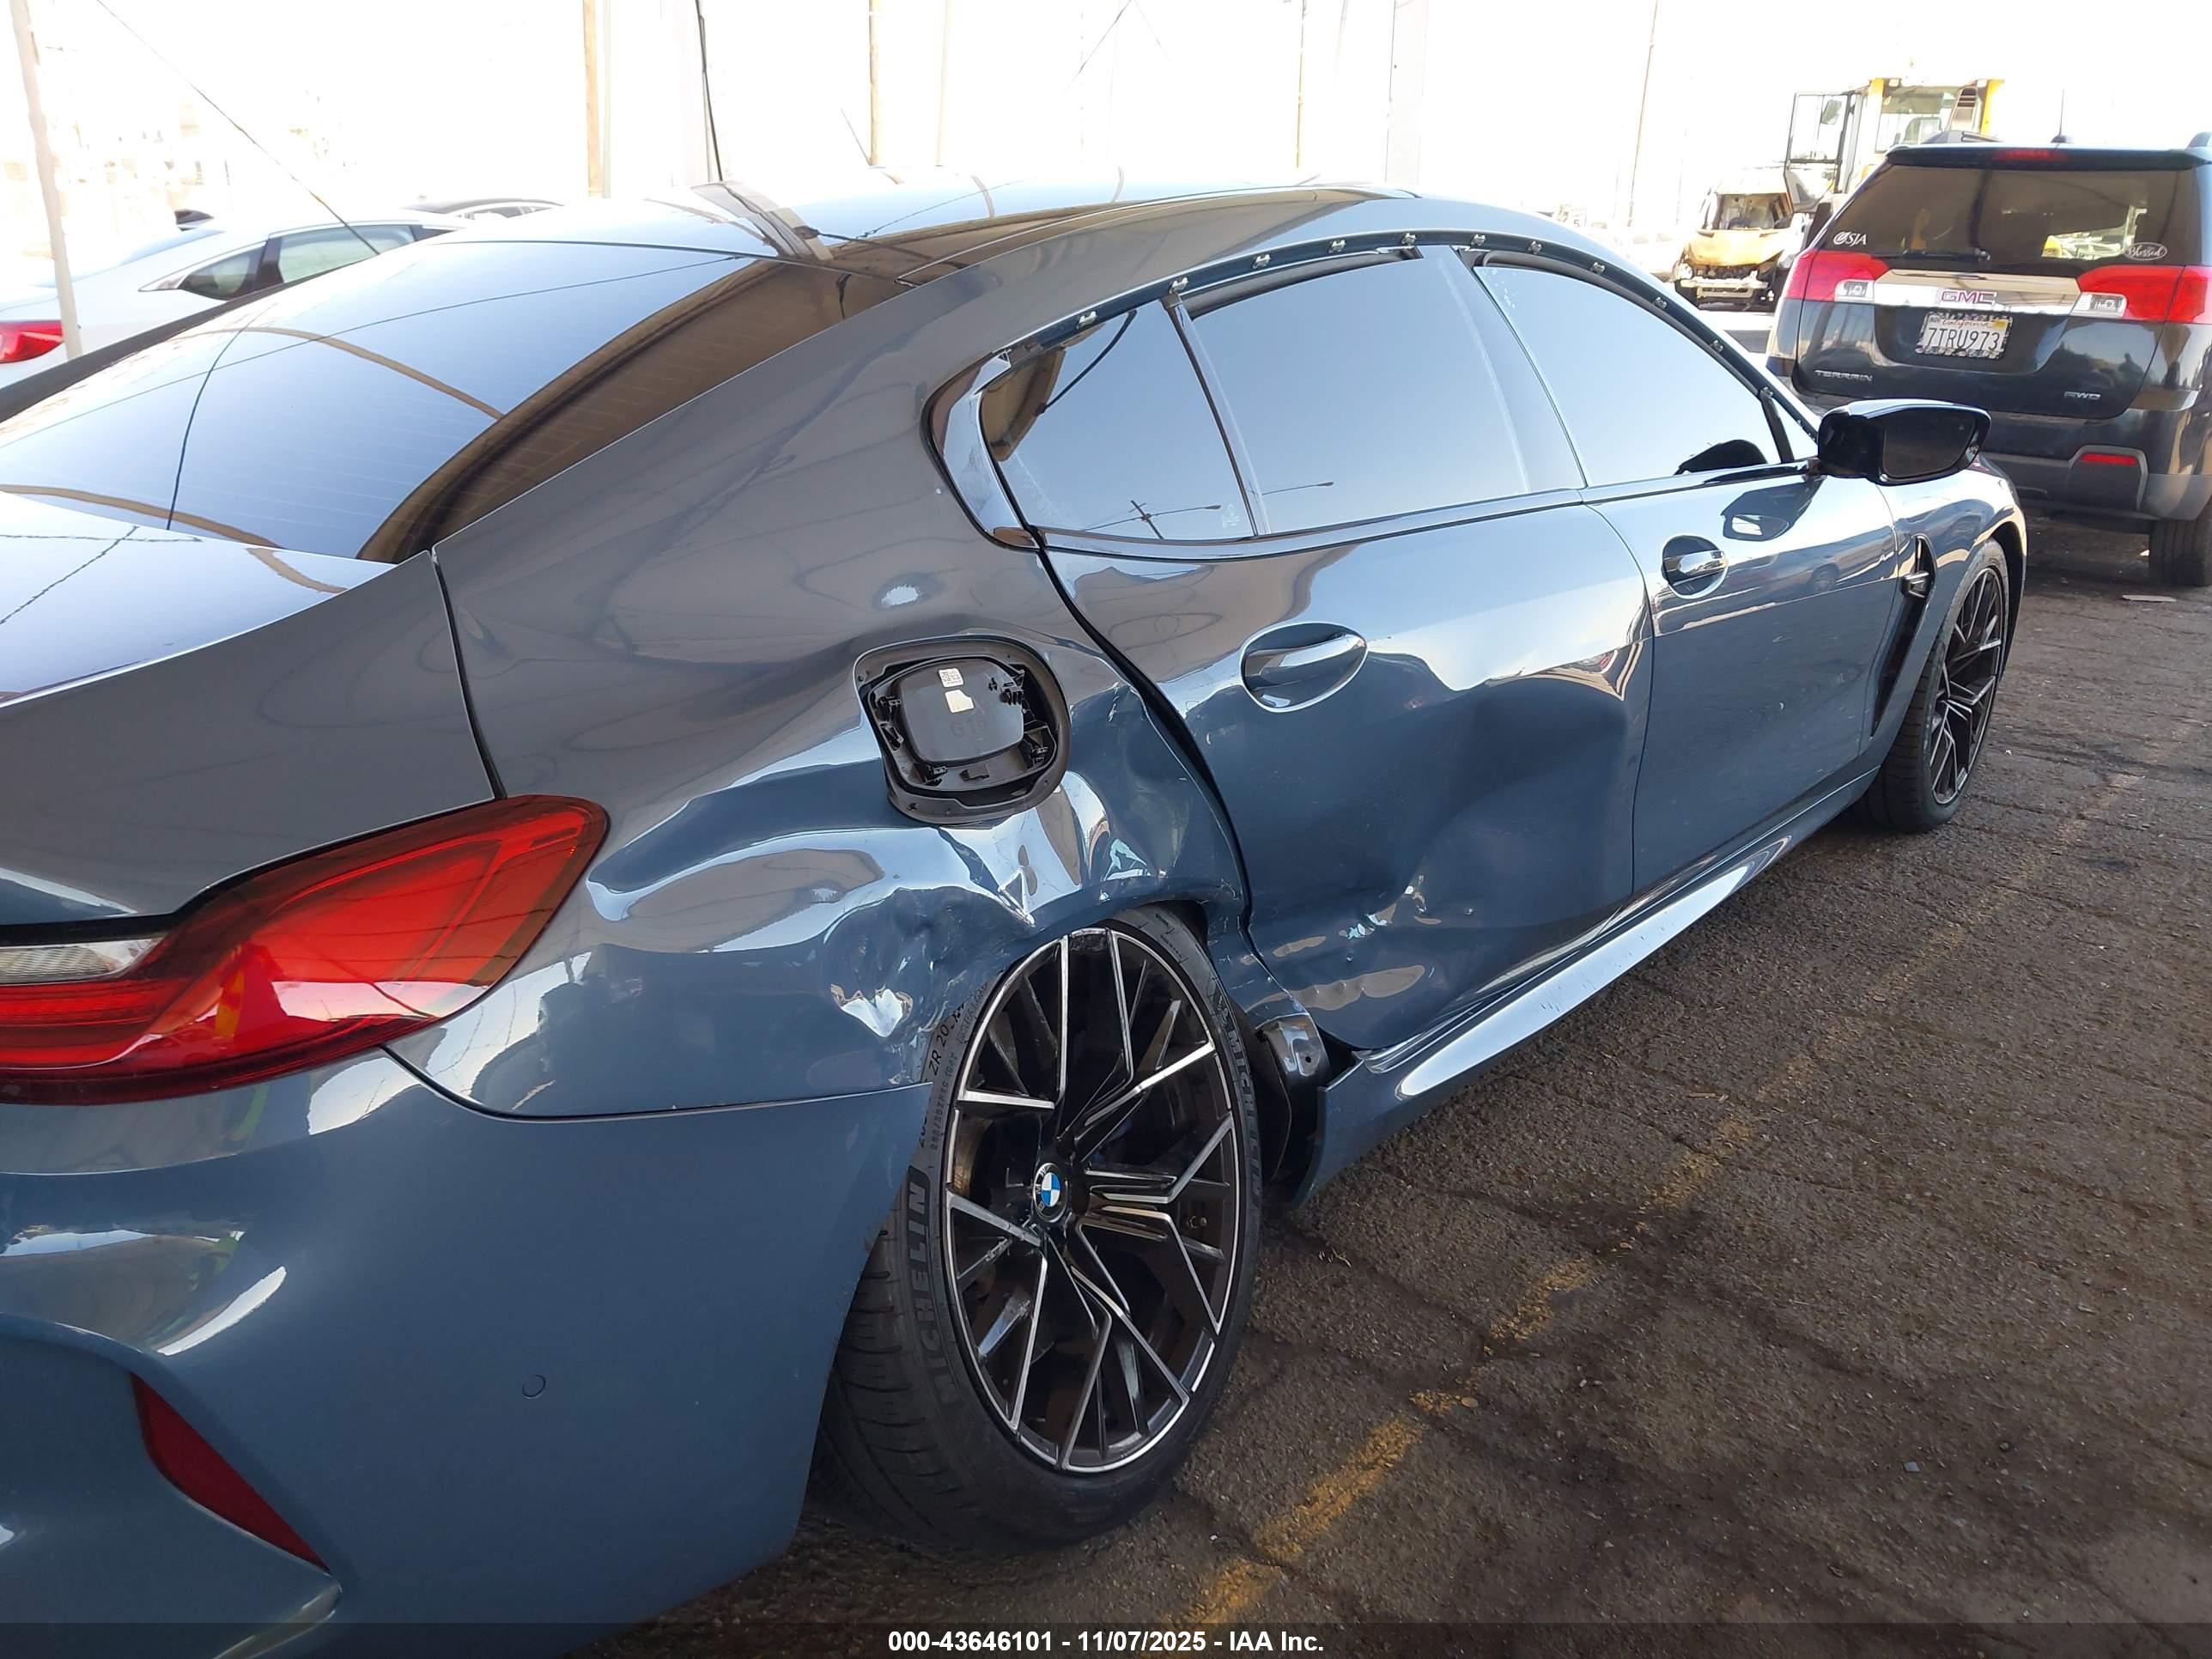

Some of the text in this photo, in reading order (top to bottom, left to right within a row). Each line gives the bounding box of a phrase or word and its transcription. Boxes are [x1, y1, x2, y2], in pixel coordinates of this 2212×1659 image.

[2129, 245, 2165, 258] Blessed
[1941, 290, 1995, 305] GMC
[1926, 327, 2000, 350] 7TRU973
[1814, 369, 1873, 381] TERRAIN
[928, 1024, 951, 1076] ZR 20
[908, 1181, 959, 1403] MICHELIN
